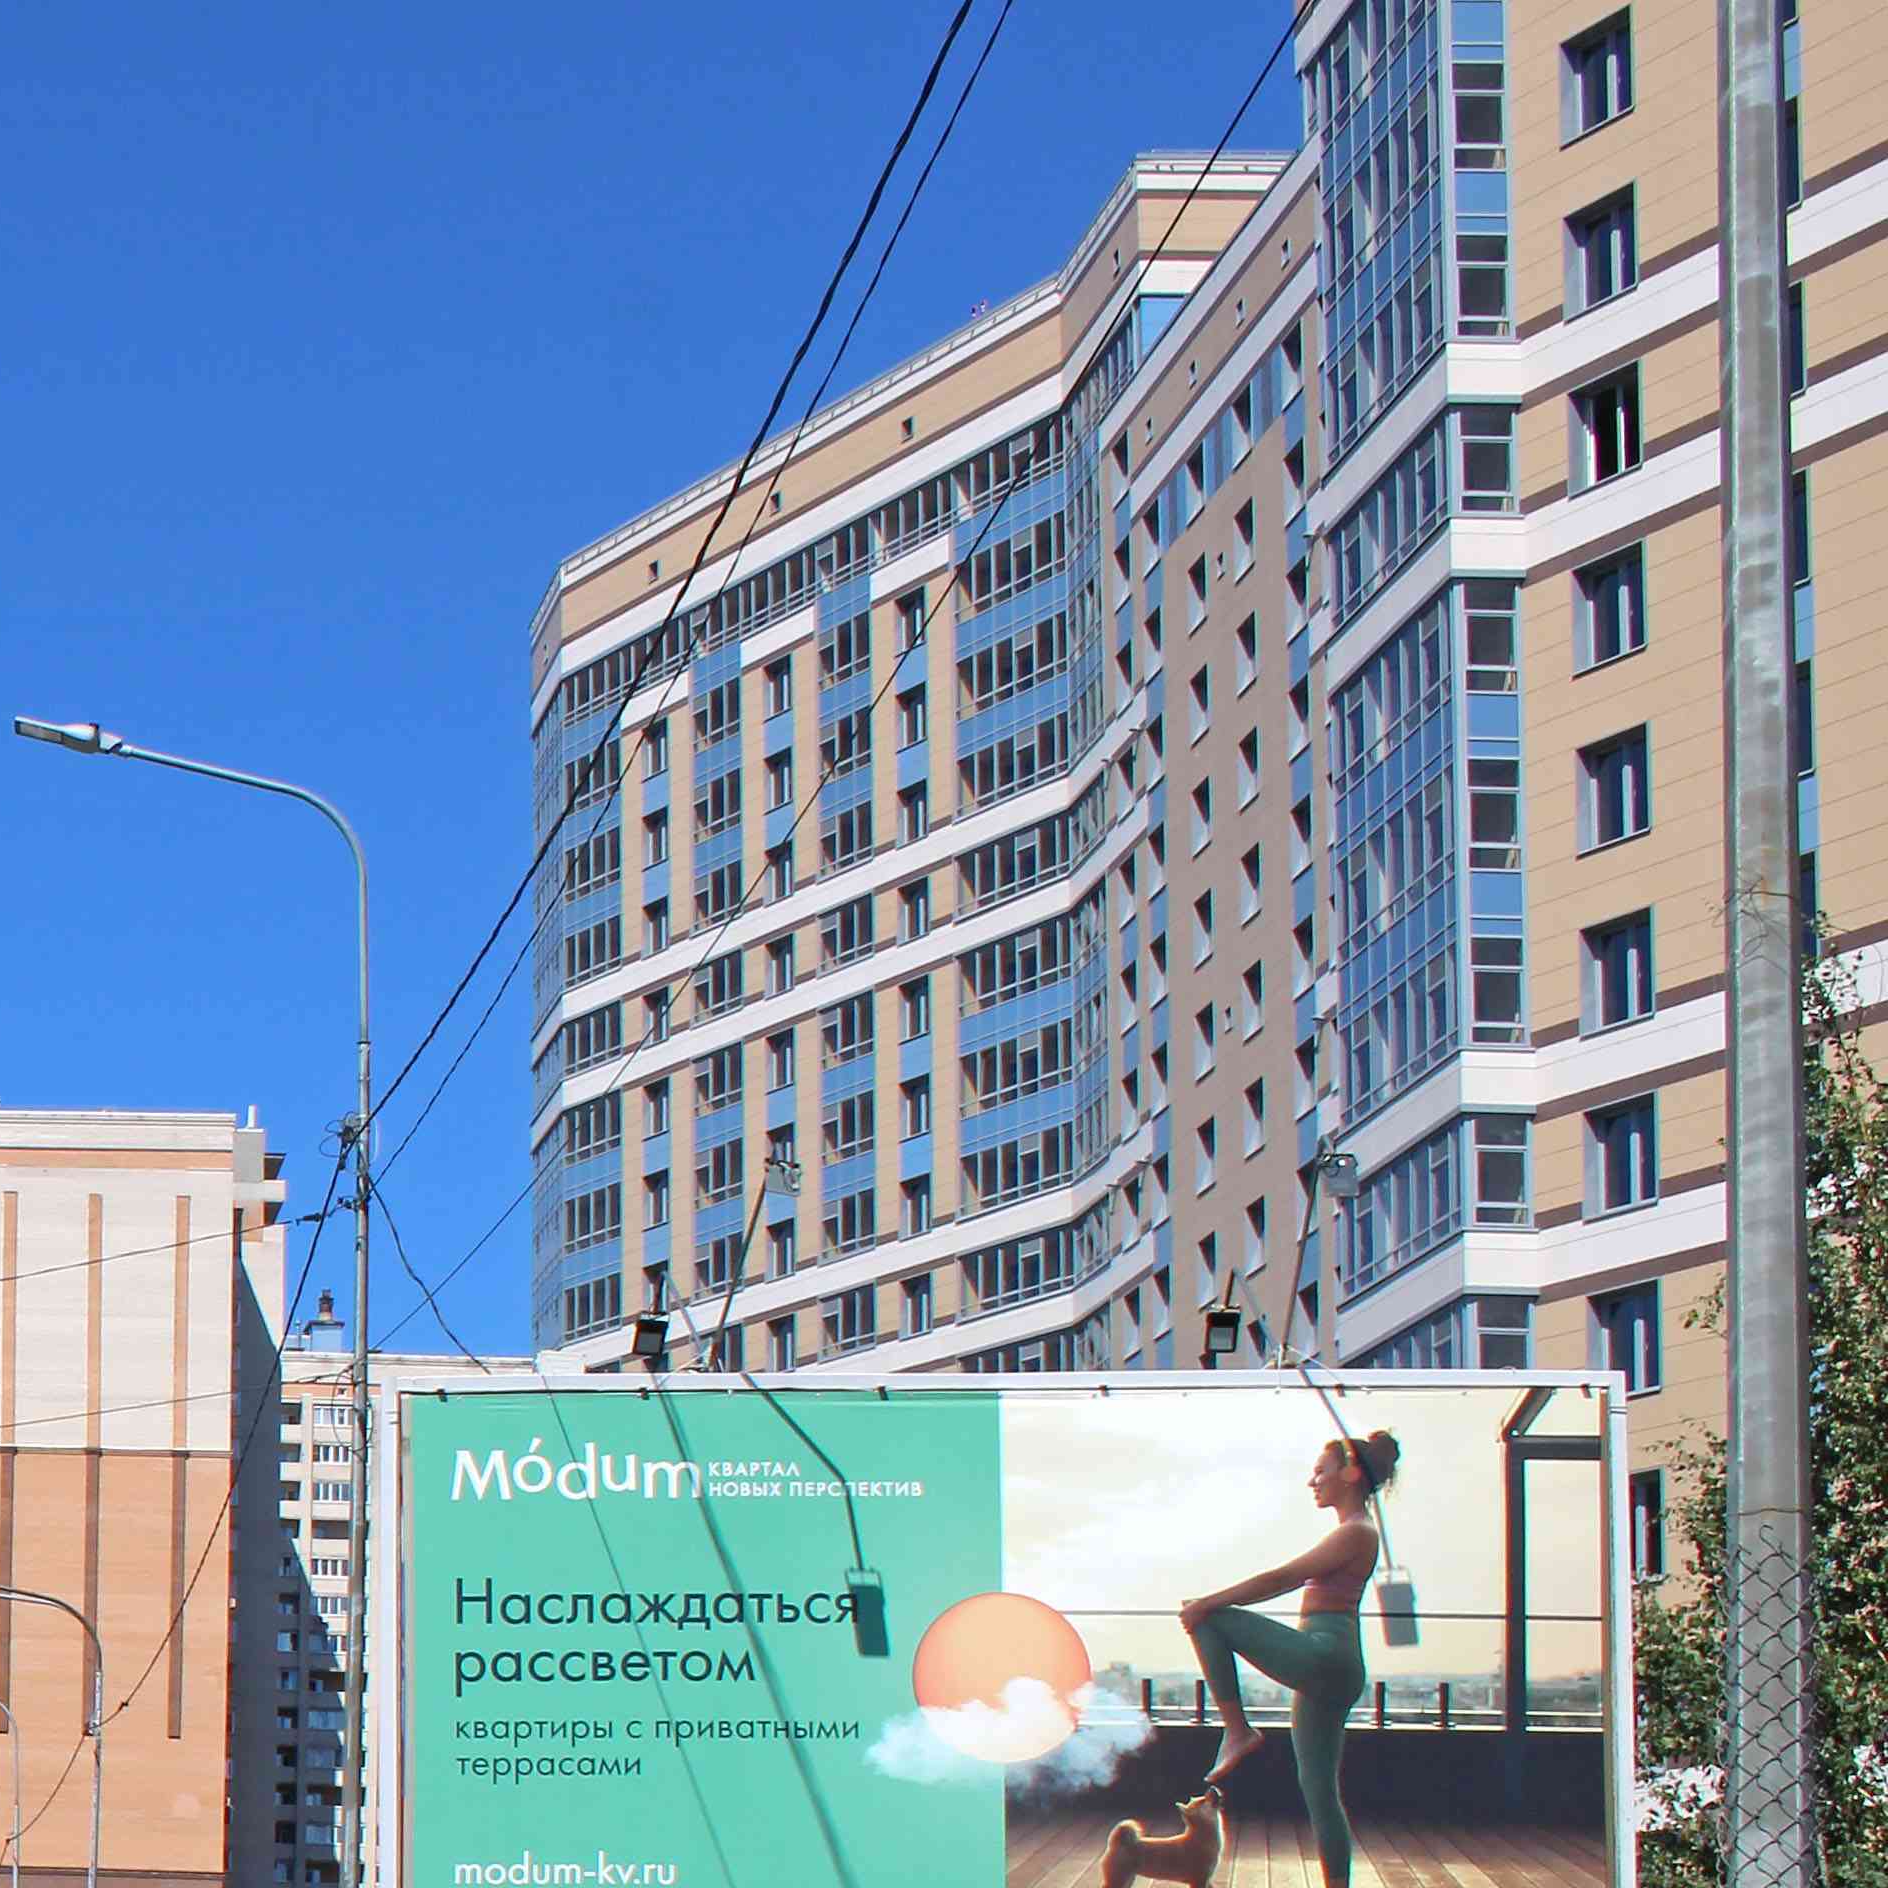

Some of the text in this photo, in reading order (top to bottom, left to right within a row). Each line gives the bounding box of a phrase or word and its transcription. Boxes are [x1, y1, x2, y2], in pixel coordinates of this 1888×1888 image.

[450, 1437, 703, 1501] Módum
[707, 1461, 800, 1477] КВАРТАЛ
[707, 1480, 923, 1498] НОВЫХ ПЕРСПЕКТИВ
[455, 1577, 858, 1631] Наслаждаться
[455, 1650, 756, 1696] рассветом
[455, 1718, 860, 1747] квартиры с приватными
[456, 1756, 641, 1785] террасами
[454, 1850, 676, 1885] modum-kv.ru
